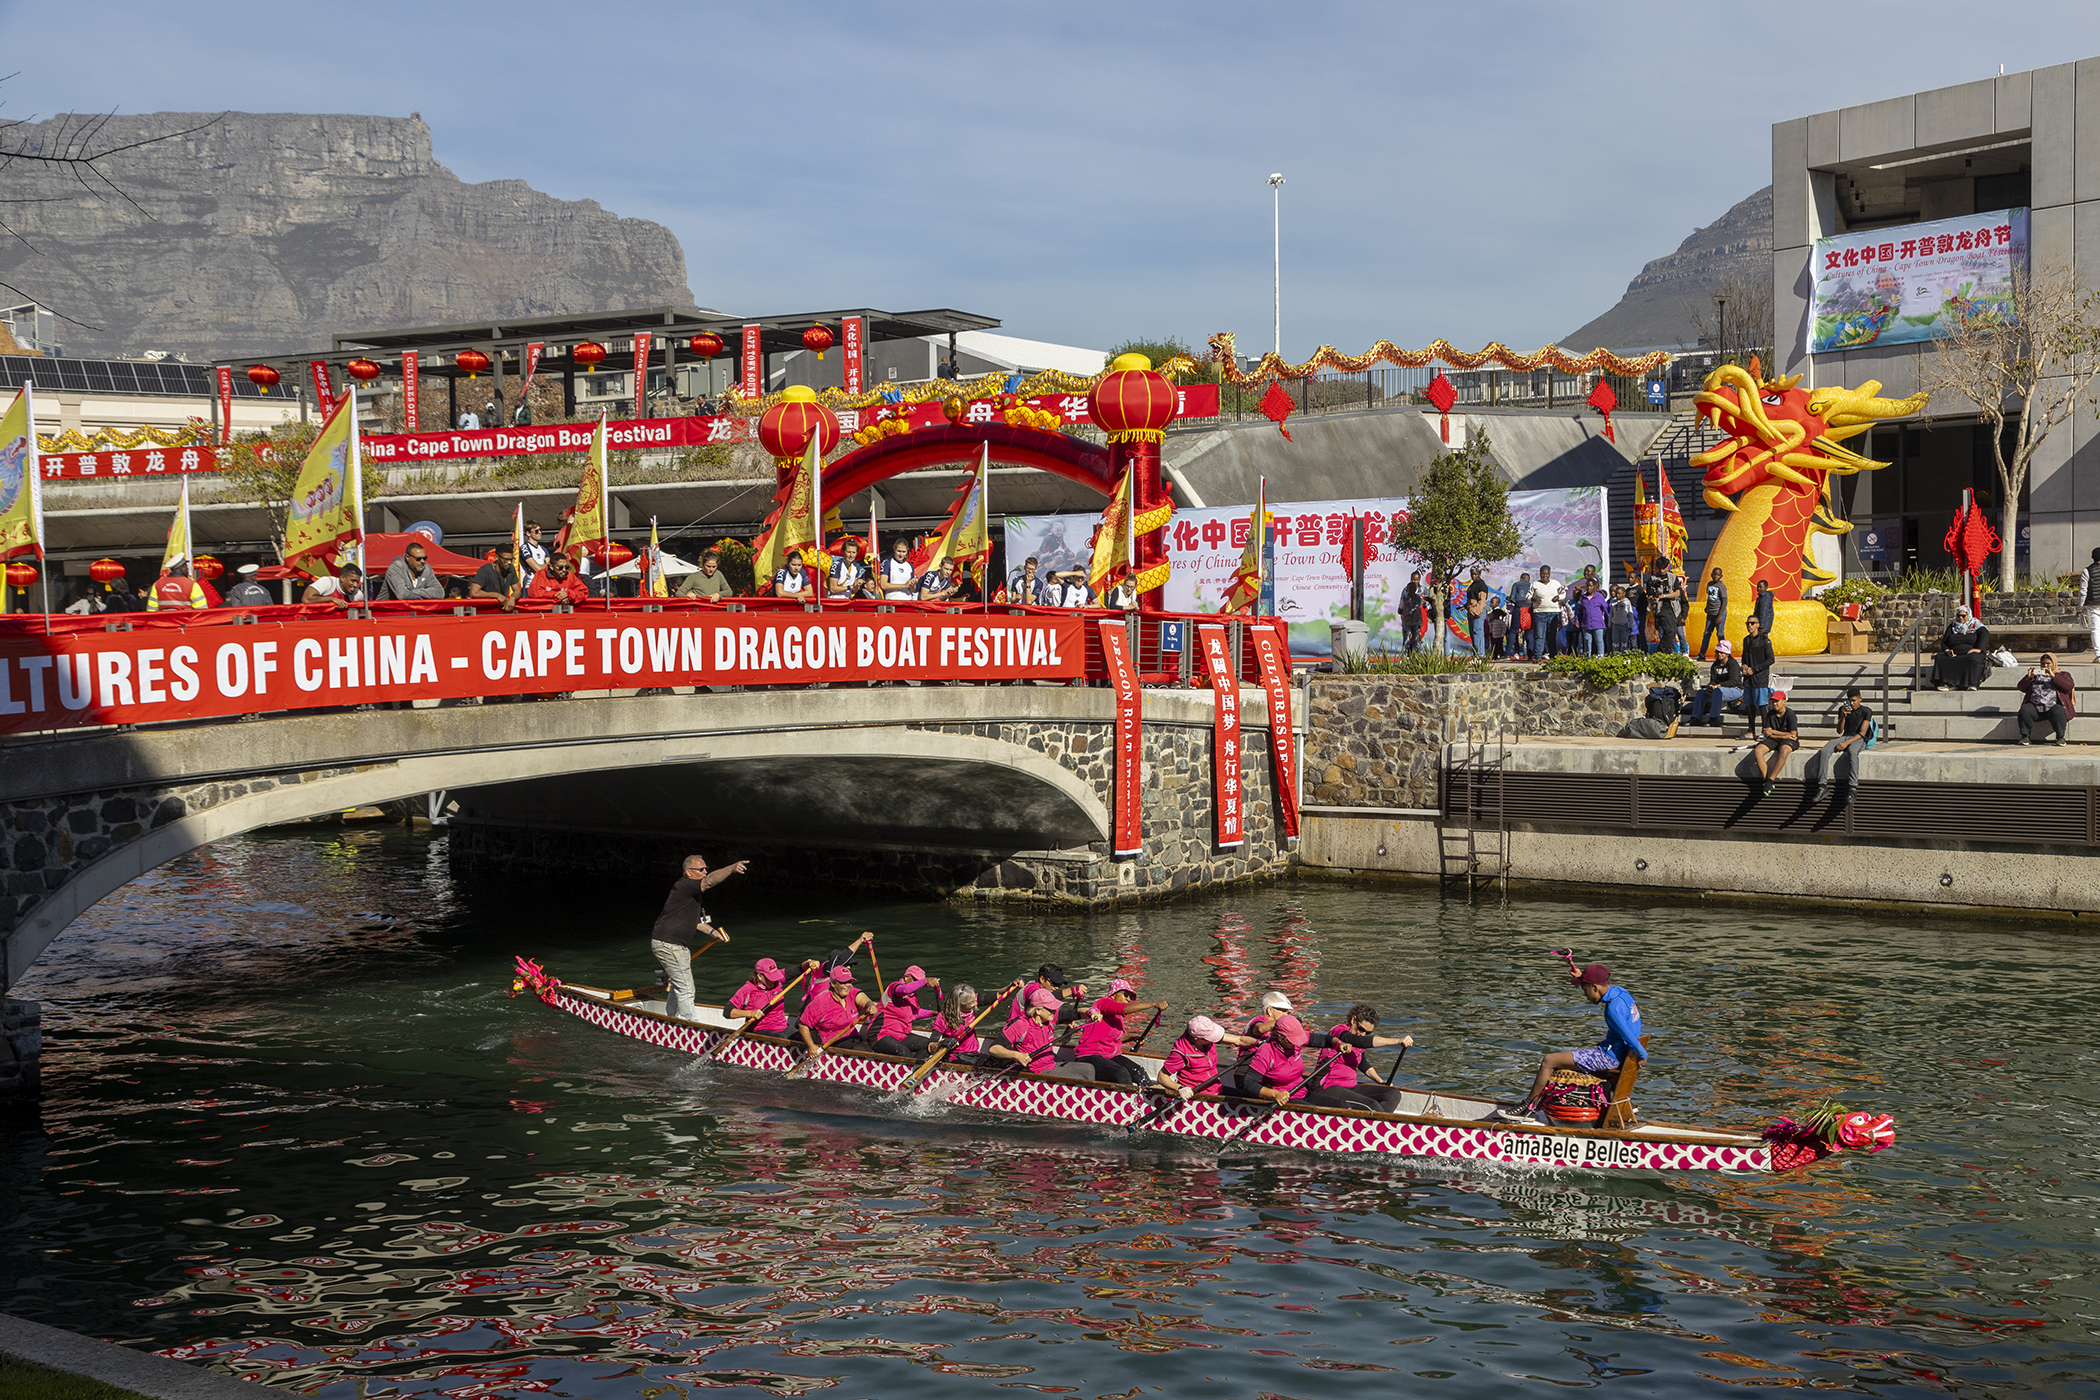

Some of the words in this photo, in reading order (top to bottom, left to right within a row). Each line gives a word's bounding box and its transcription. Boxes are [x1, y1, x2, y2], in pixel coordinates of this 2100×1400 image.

[747, 330, 756, 349] CAPE
[747, 351, 756, 371] TOWN
[747, 373, 756, 397] SOUTH
[407, 438, 449, 457] Cape
[451, 436, 493, 452] Town
[496, 432, 551, 451] Dragon
[606, 424, 671, 443] Festival
[1190, 554, 1204, 573] of
[1205, 554, 1238, 570] China
[1282, 552, 1315, 565] Town
[1314, 583, 1343, 591] Community
[215, 641, 278, 698] OF
[293, 634, 439, 692] CHINA
[482, 629, 586, 681] CAPE
[595, 626, 703, 675] TOWN
[713, 625, 847, 671] DRAGON
[857, 625, 933, 668] BOAT
[940, 626, 1063, 668] FESTIVAL
[1109, 634, 1134, 702] DRAGON
[1260, 639, 1288, 736] CULTURES
[1504, 1137, 1580, 1159] amaBele
[1585, 1140, 1640, 1164] Belles
